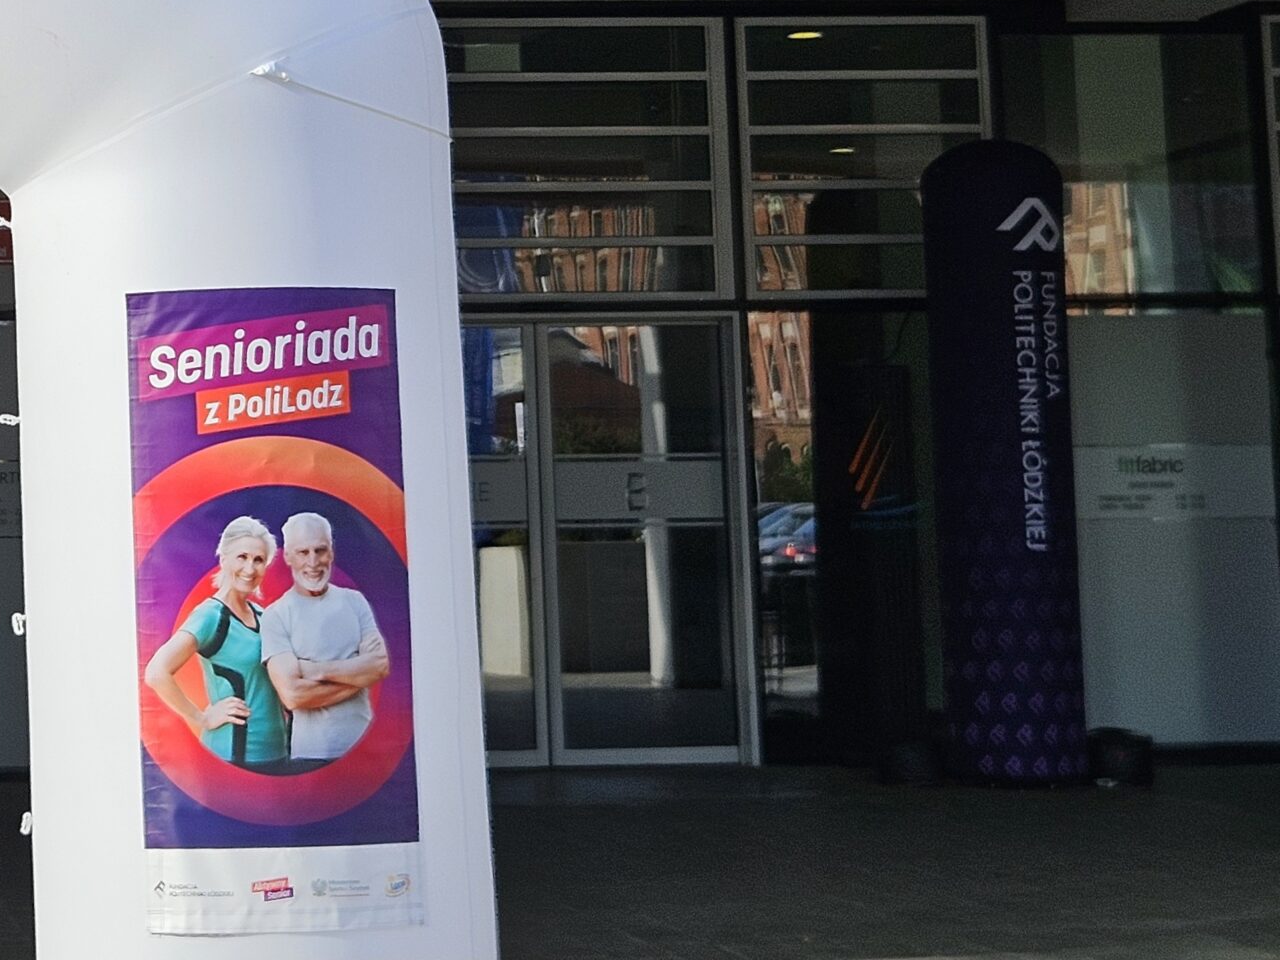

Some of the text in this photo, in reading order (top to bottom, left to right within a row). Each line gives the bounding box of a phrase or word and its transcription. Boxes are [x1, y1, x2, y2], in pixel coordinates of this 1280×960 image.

[148, 315, 379, 389] Senioriada
[1041, 271, 1061, 398] FUNDACJA
[204, 379, 344, 425] z PoliLodz
[1012, 270, 1049, 552] POLITECHNIKI ŁÓDZKIEJ
